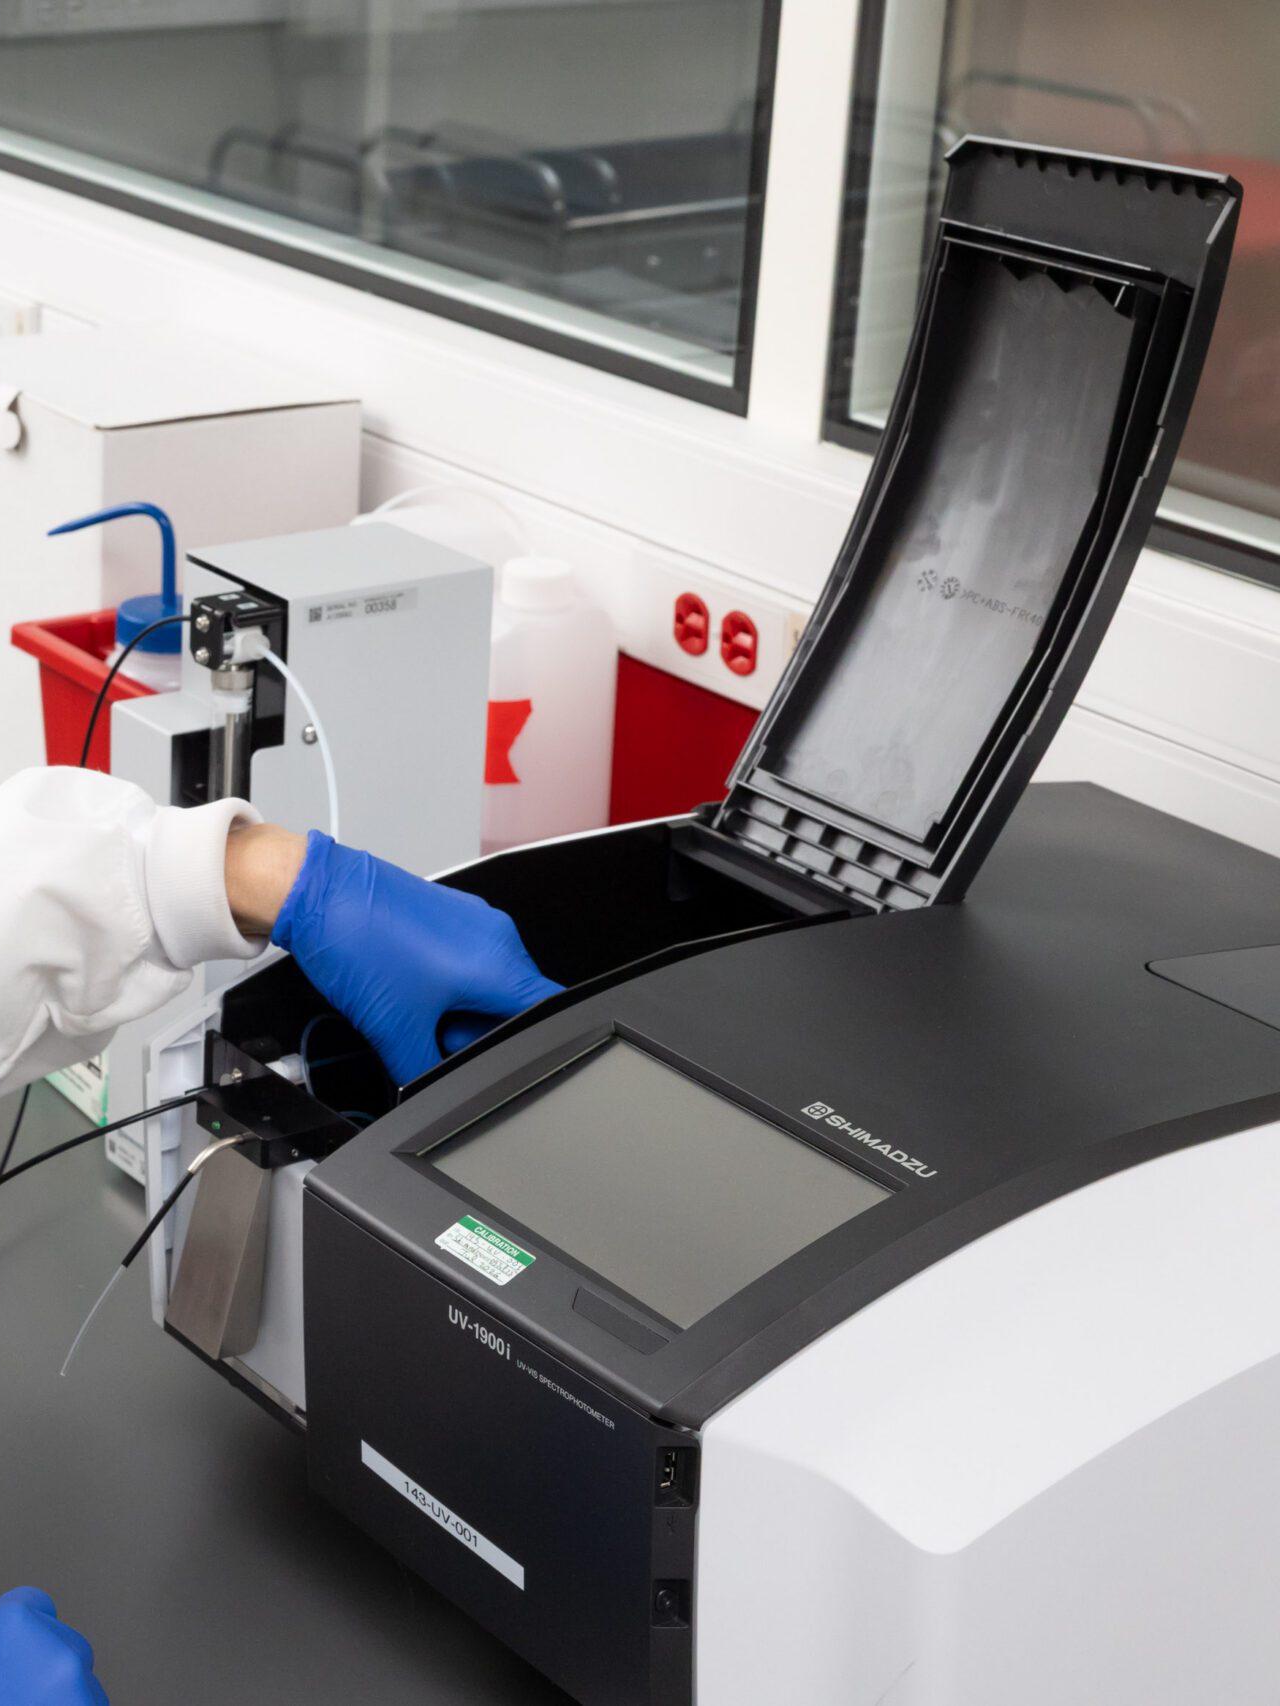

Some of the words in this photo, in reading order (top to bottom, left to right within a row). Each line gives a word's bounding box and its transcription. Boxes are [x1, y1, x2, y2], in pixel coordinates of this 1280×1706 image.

[824, 1114, 939, 1178] SHIMADZU
[474, 1226, 520, 1257] CALIBRATION
[516, 1359, 539, 1380] UV-VIS
[538, 1374, 616, 1430] SPECTROPHOTOMETER
[403, 1481, 479, 1548] 143-UV-001
